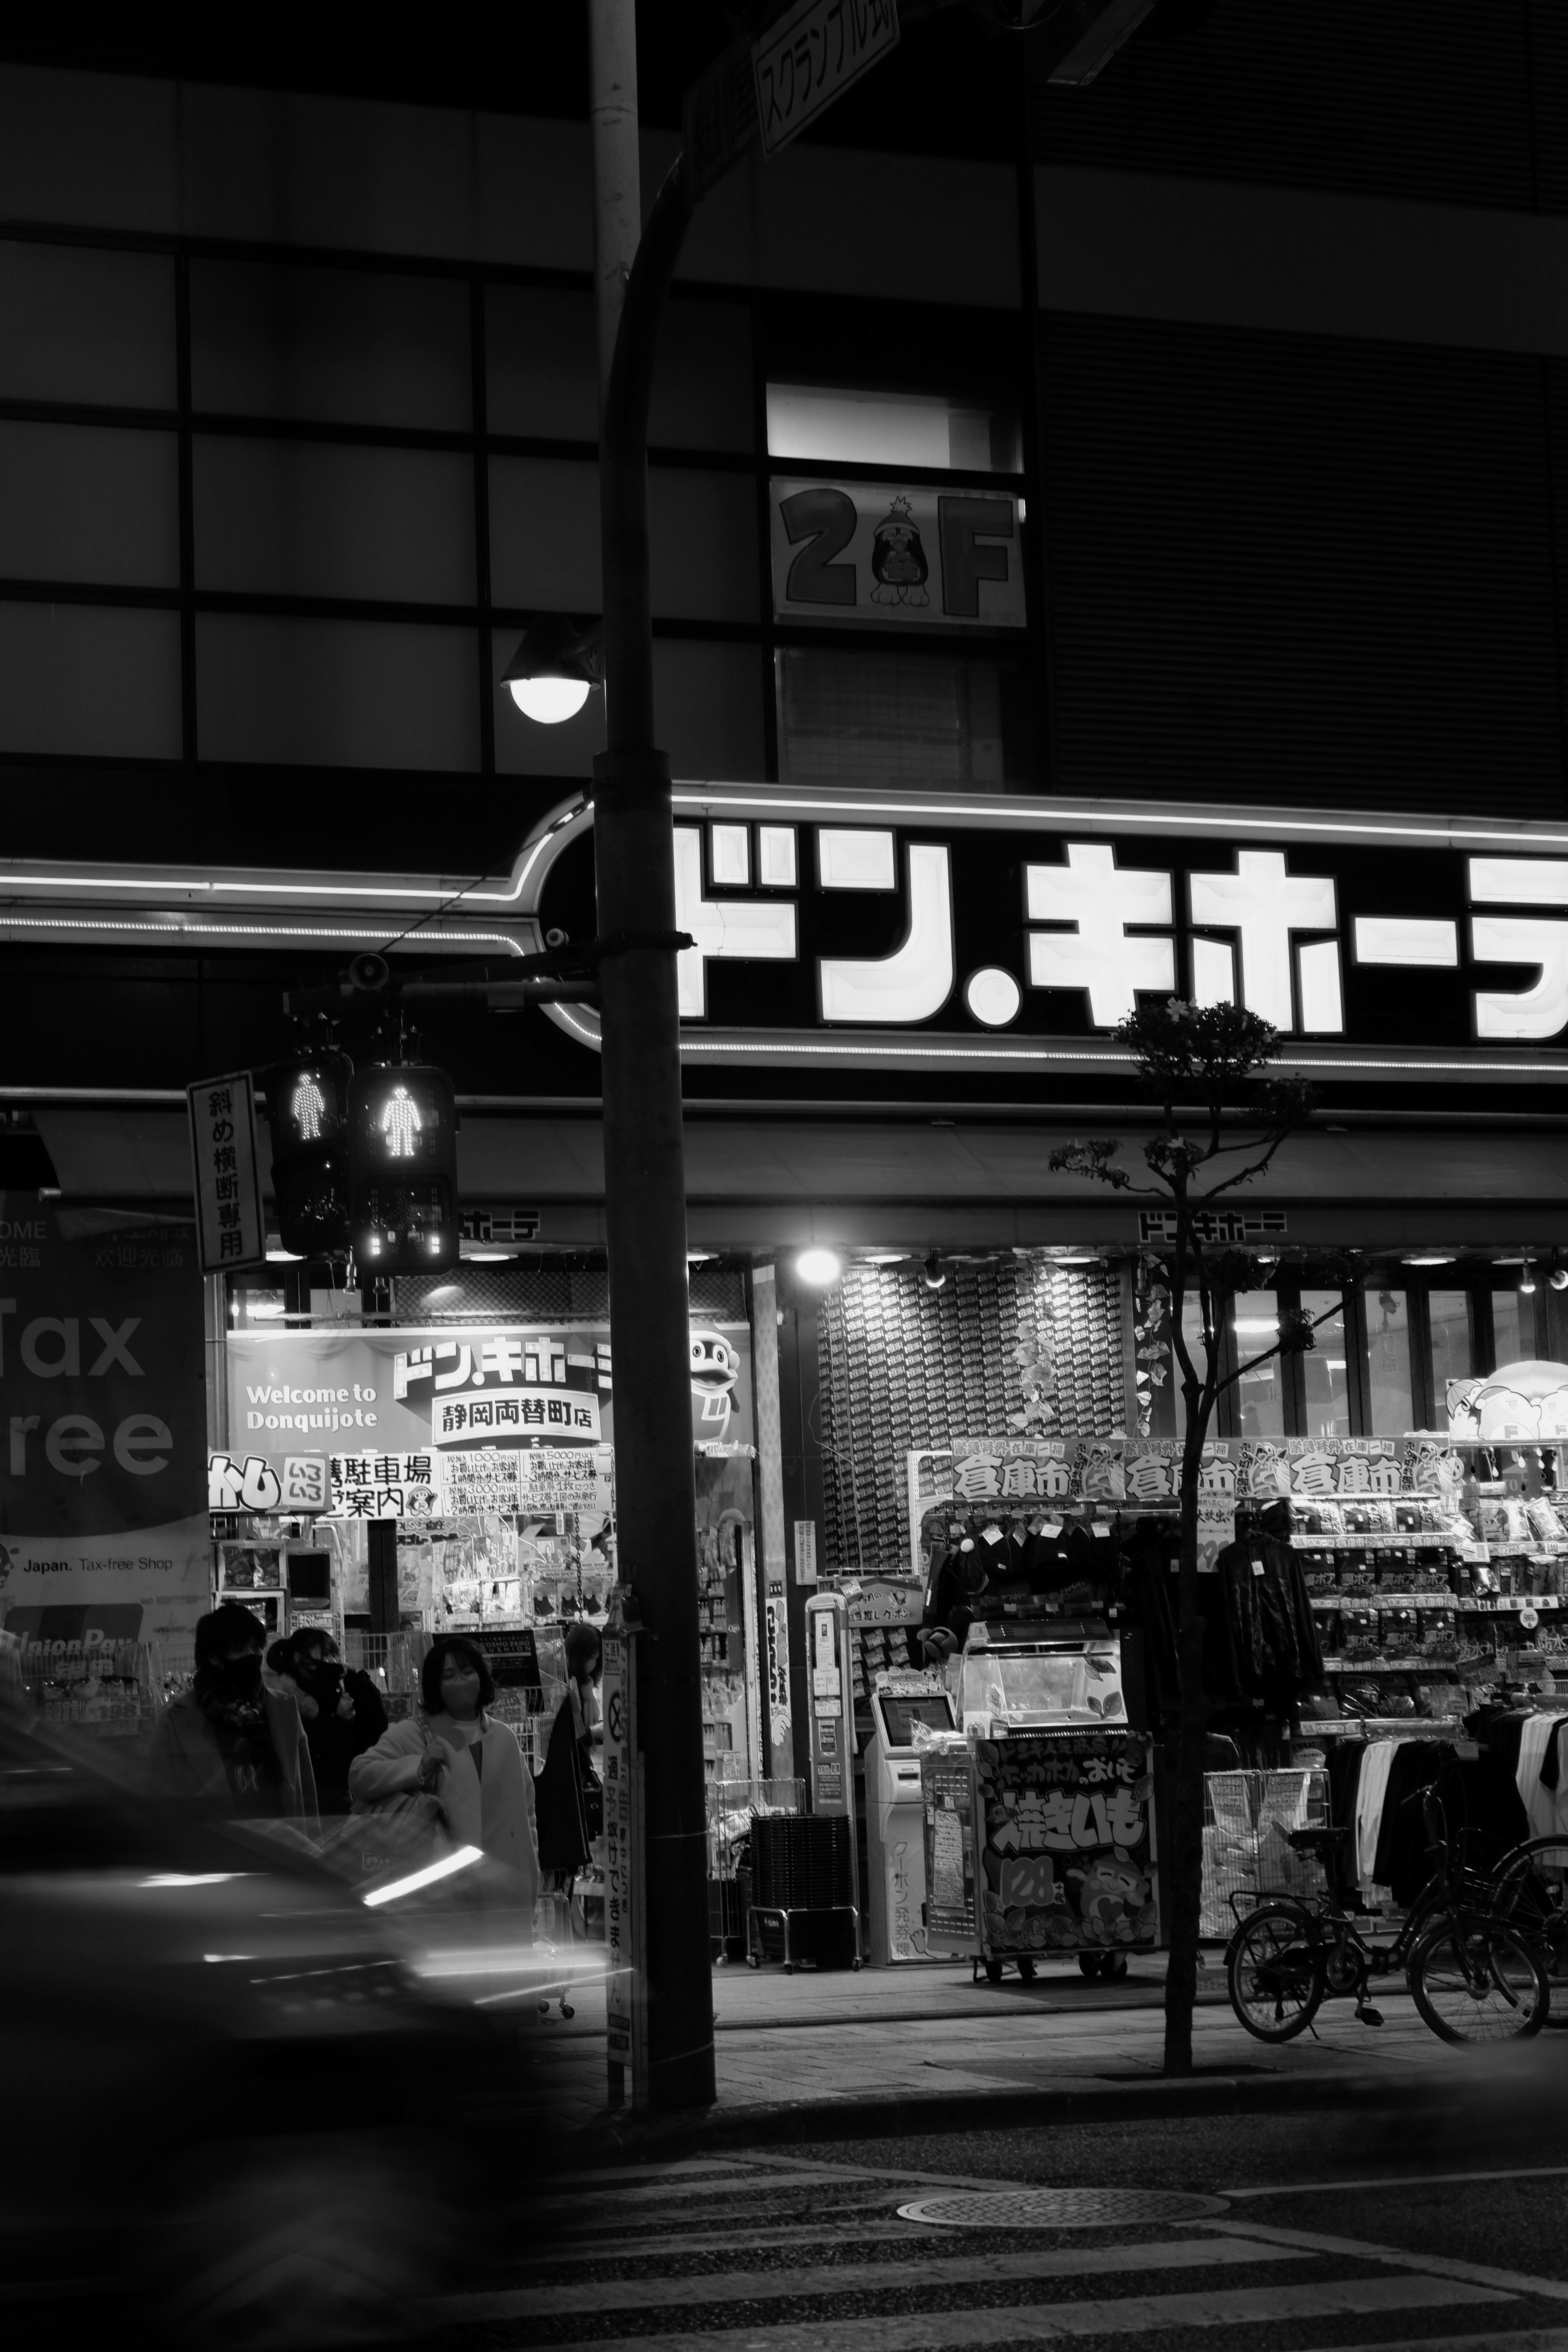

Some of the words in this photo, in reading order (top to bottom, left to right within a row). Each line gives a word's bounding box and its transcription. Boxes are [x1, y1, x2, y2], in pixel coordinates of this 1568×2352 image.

[779, 488, 857, 606] 2
[938, 496, 1014, 617] F
[208, 1089, 243, 1259] 斜め横断専用
[94, 1245, 183, 1267] 欢迎光临
[246, 1385, 349, 1405] Welcome
[353, 1383, 377, 1403] to
[247, 1406, 378, 1433] Donquijote
[442, 1398, 592, 1433] 静岡両替町店
[10, 1414, 173, 1476] ree
[1010, 1441, 1065, 1458] 在庫一掃
[1176, 1441, 1229, 1458] 在一掃
[1342, 1439, 1395, 1456] 在庫一掃
[953, 1455, 1072, 1498] 倉庫市
[1125, 1455, 1237, 1498] 倉市
[1290, 1453, 1403, 1494] 倉庫市
[24, 1559, 72, 1574] Japan.
[80, 1558, 134, 1571] Tax-free
[138, 1557, 173, 1572] Shop
